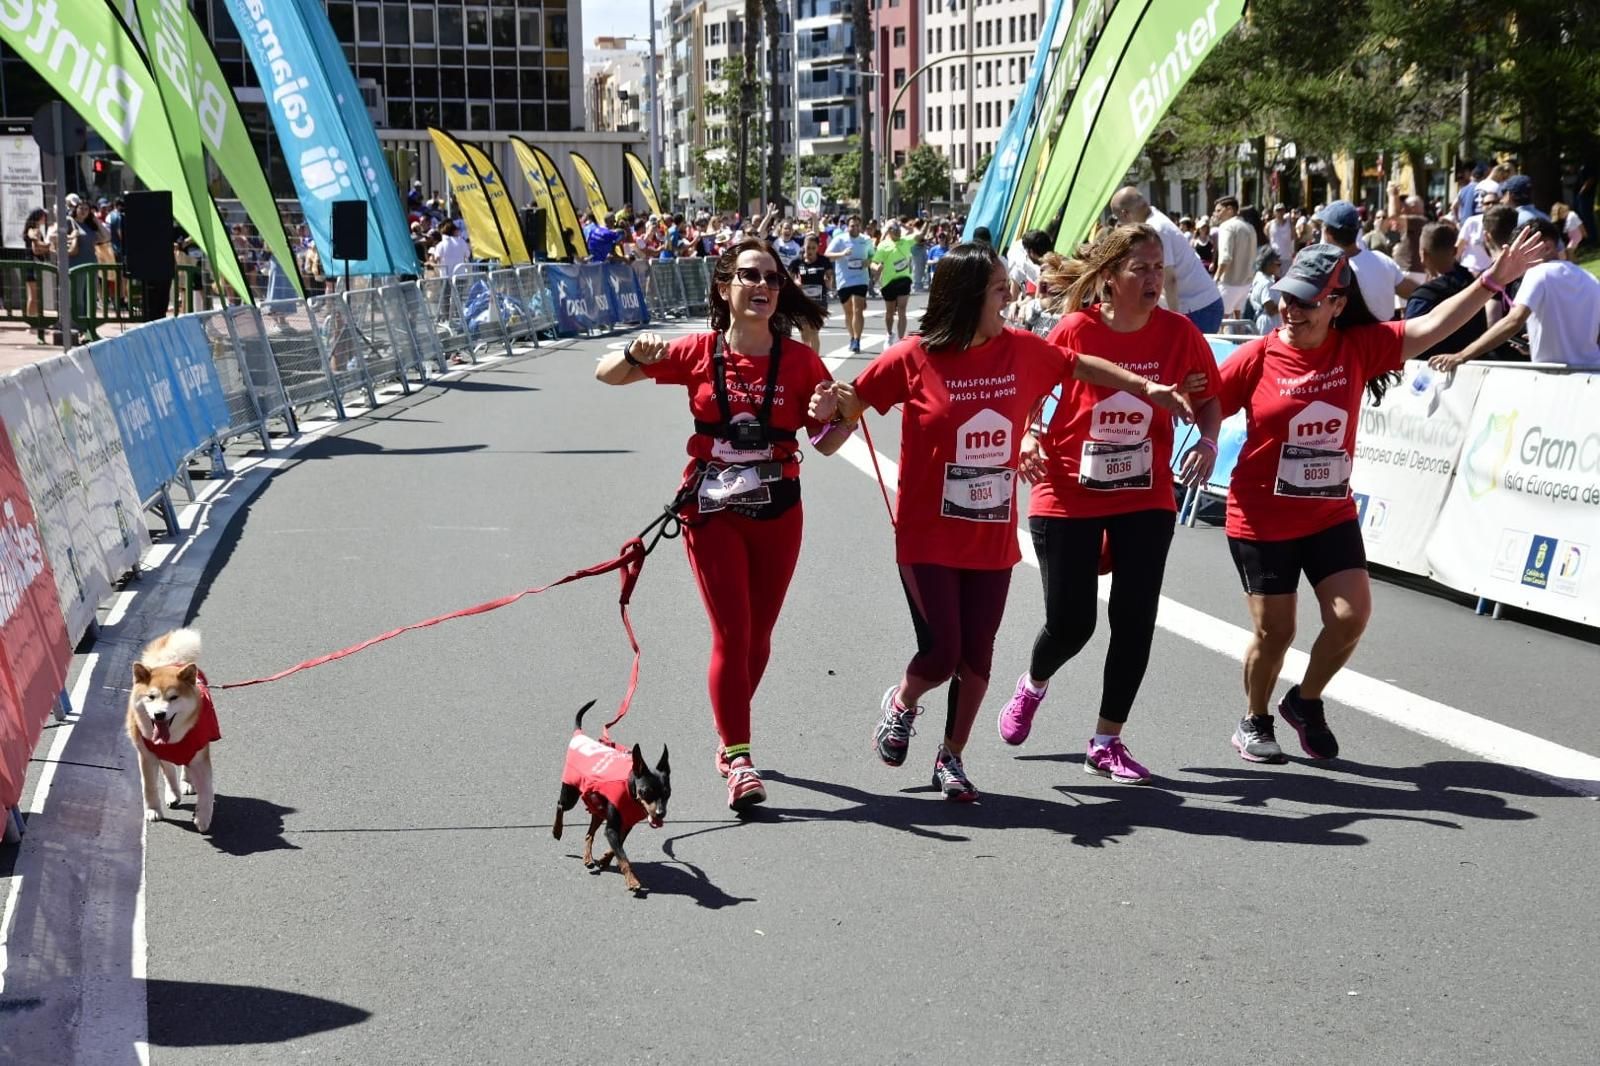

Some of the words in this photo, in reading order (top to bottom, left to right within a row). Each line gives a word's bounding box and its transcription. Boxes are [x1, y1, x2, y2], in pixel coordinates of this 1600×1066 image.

[1128, 0, 1221, 139] Binter
[945, 373, 1015, 389] TRANSFORMANDO
[1321, 376, 1347, 391] APOYO
[949, 391, 977, 402] PASOS
[980, 390, 991, 400] EN
[1099, 411, 1144, 425] me
[1297, 418, 1342, 437] me
[965, 429, 1007, 449] me
[1106, 460, 1132, 475] 8036
[1409, 449, 1451, 475] Deporte
[1304, 467, 1330, 481] 8039
[970, 486, 993, 502] 8034
[1526, 474, 1579, 503] Europea
